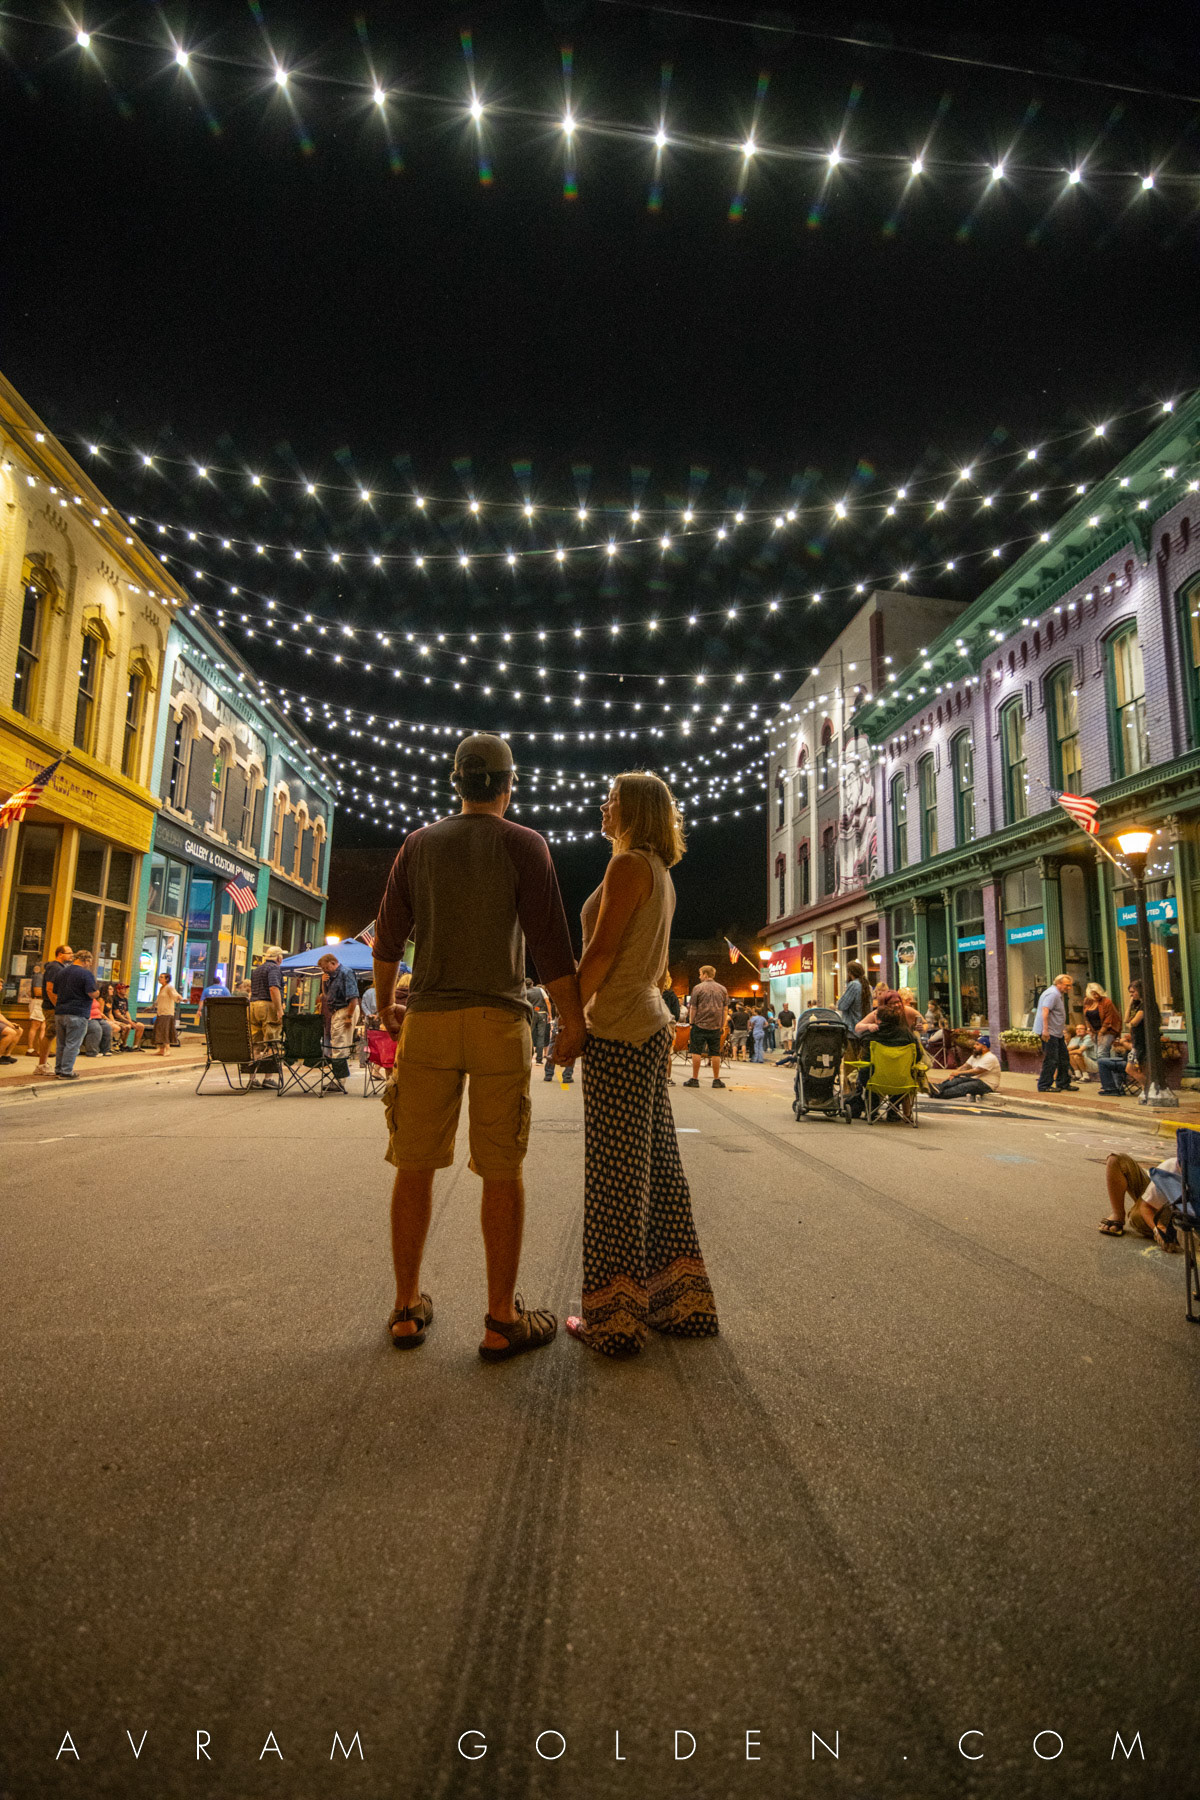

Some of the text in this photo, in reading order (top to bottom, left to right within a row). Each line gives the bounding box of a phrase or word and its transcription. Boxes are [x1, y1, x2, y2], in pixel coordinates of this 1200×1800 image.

[184, 839, 210, 861] GALLERY
[209, 851, 214, 864] &
[214, 854, 236, 875] CUSTOM
